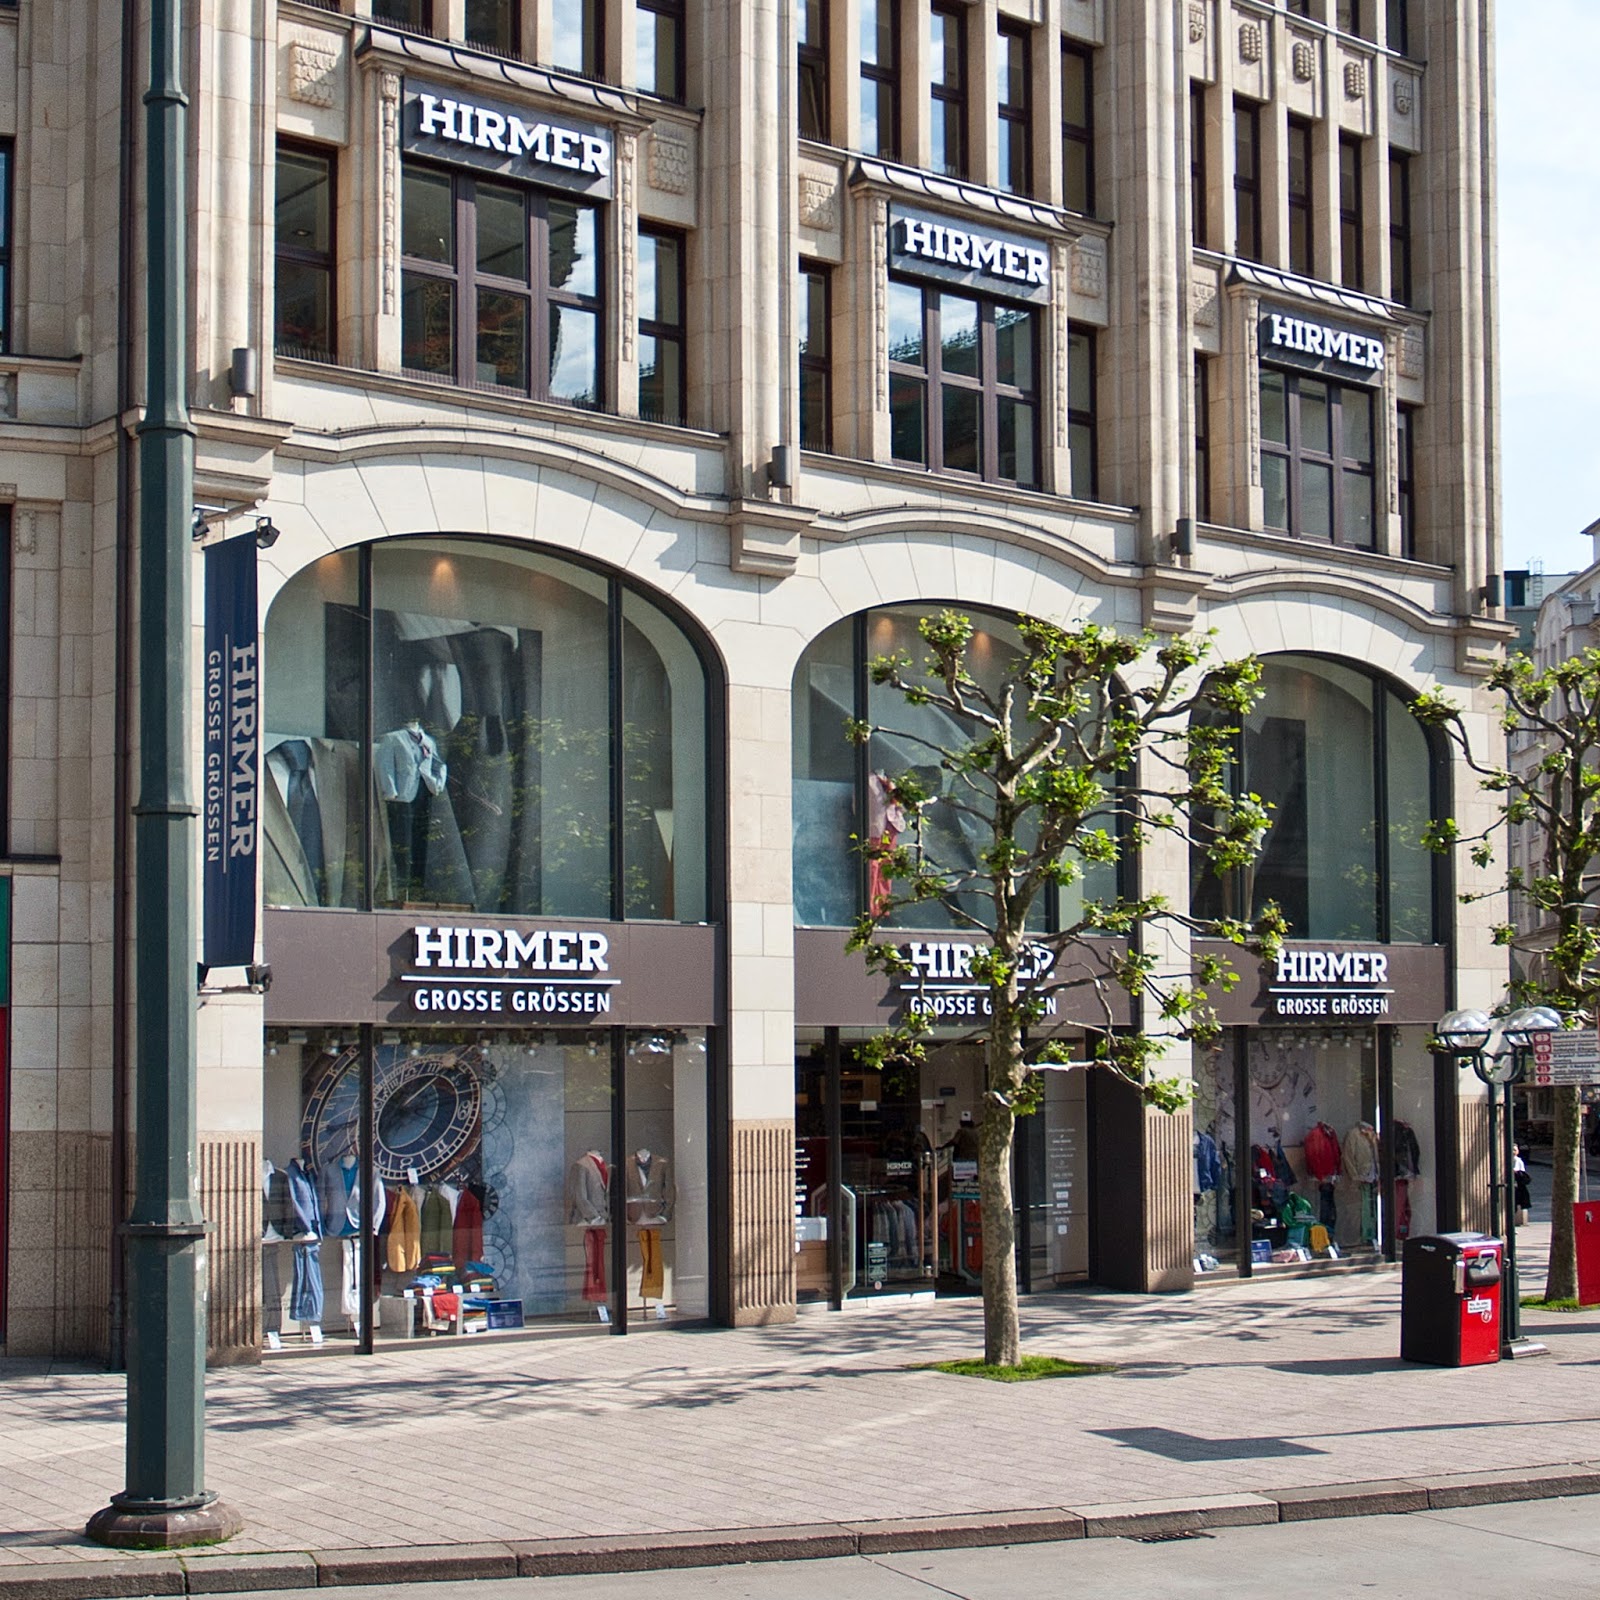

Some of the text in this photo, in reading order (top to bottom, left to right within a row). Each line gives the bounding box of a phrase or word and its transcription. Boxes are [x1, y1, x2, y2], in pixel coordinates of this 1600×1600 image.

[419, 93, 611, 176] HIRMER
[904, 217, 1049, 285] HIRMER
[1271, 314, 1385, 370] HIRMER
[208, 650, 223, 861] GROSSE GRÖSSEN
[230, 642, 256, 858] HIRMER
[415, 926, 609, 972] HIRMER
[1277, 950, 1388, 983] HIRMER
[414, 986, 610, 1013] GROSSE GRÖSSEN
[910, 996, 976, 1016] GROSSE
[1277, 995, 1389, 1015] GROSSE GRÖSSEN
